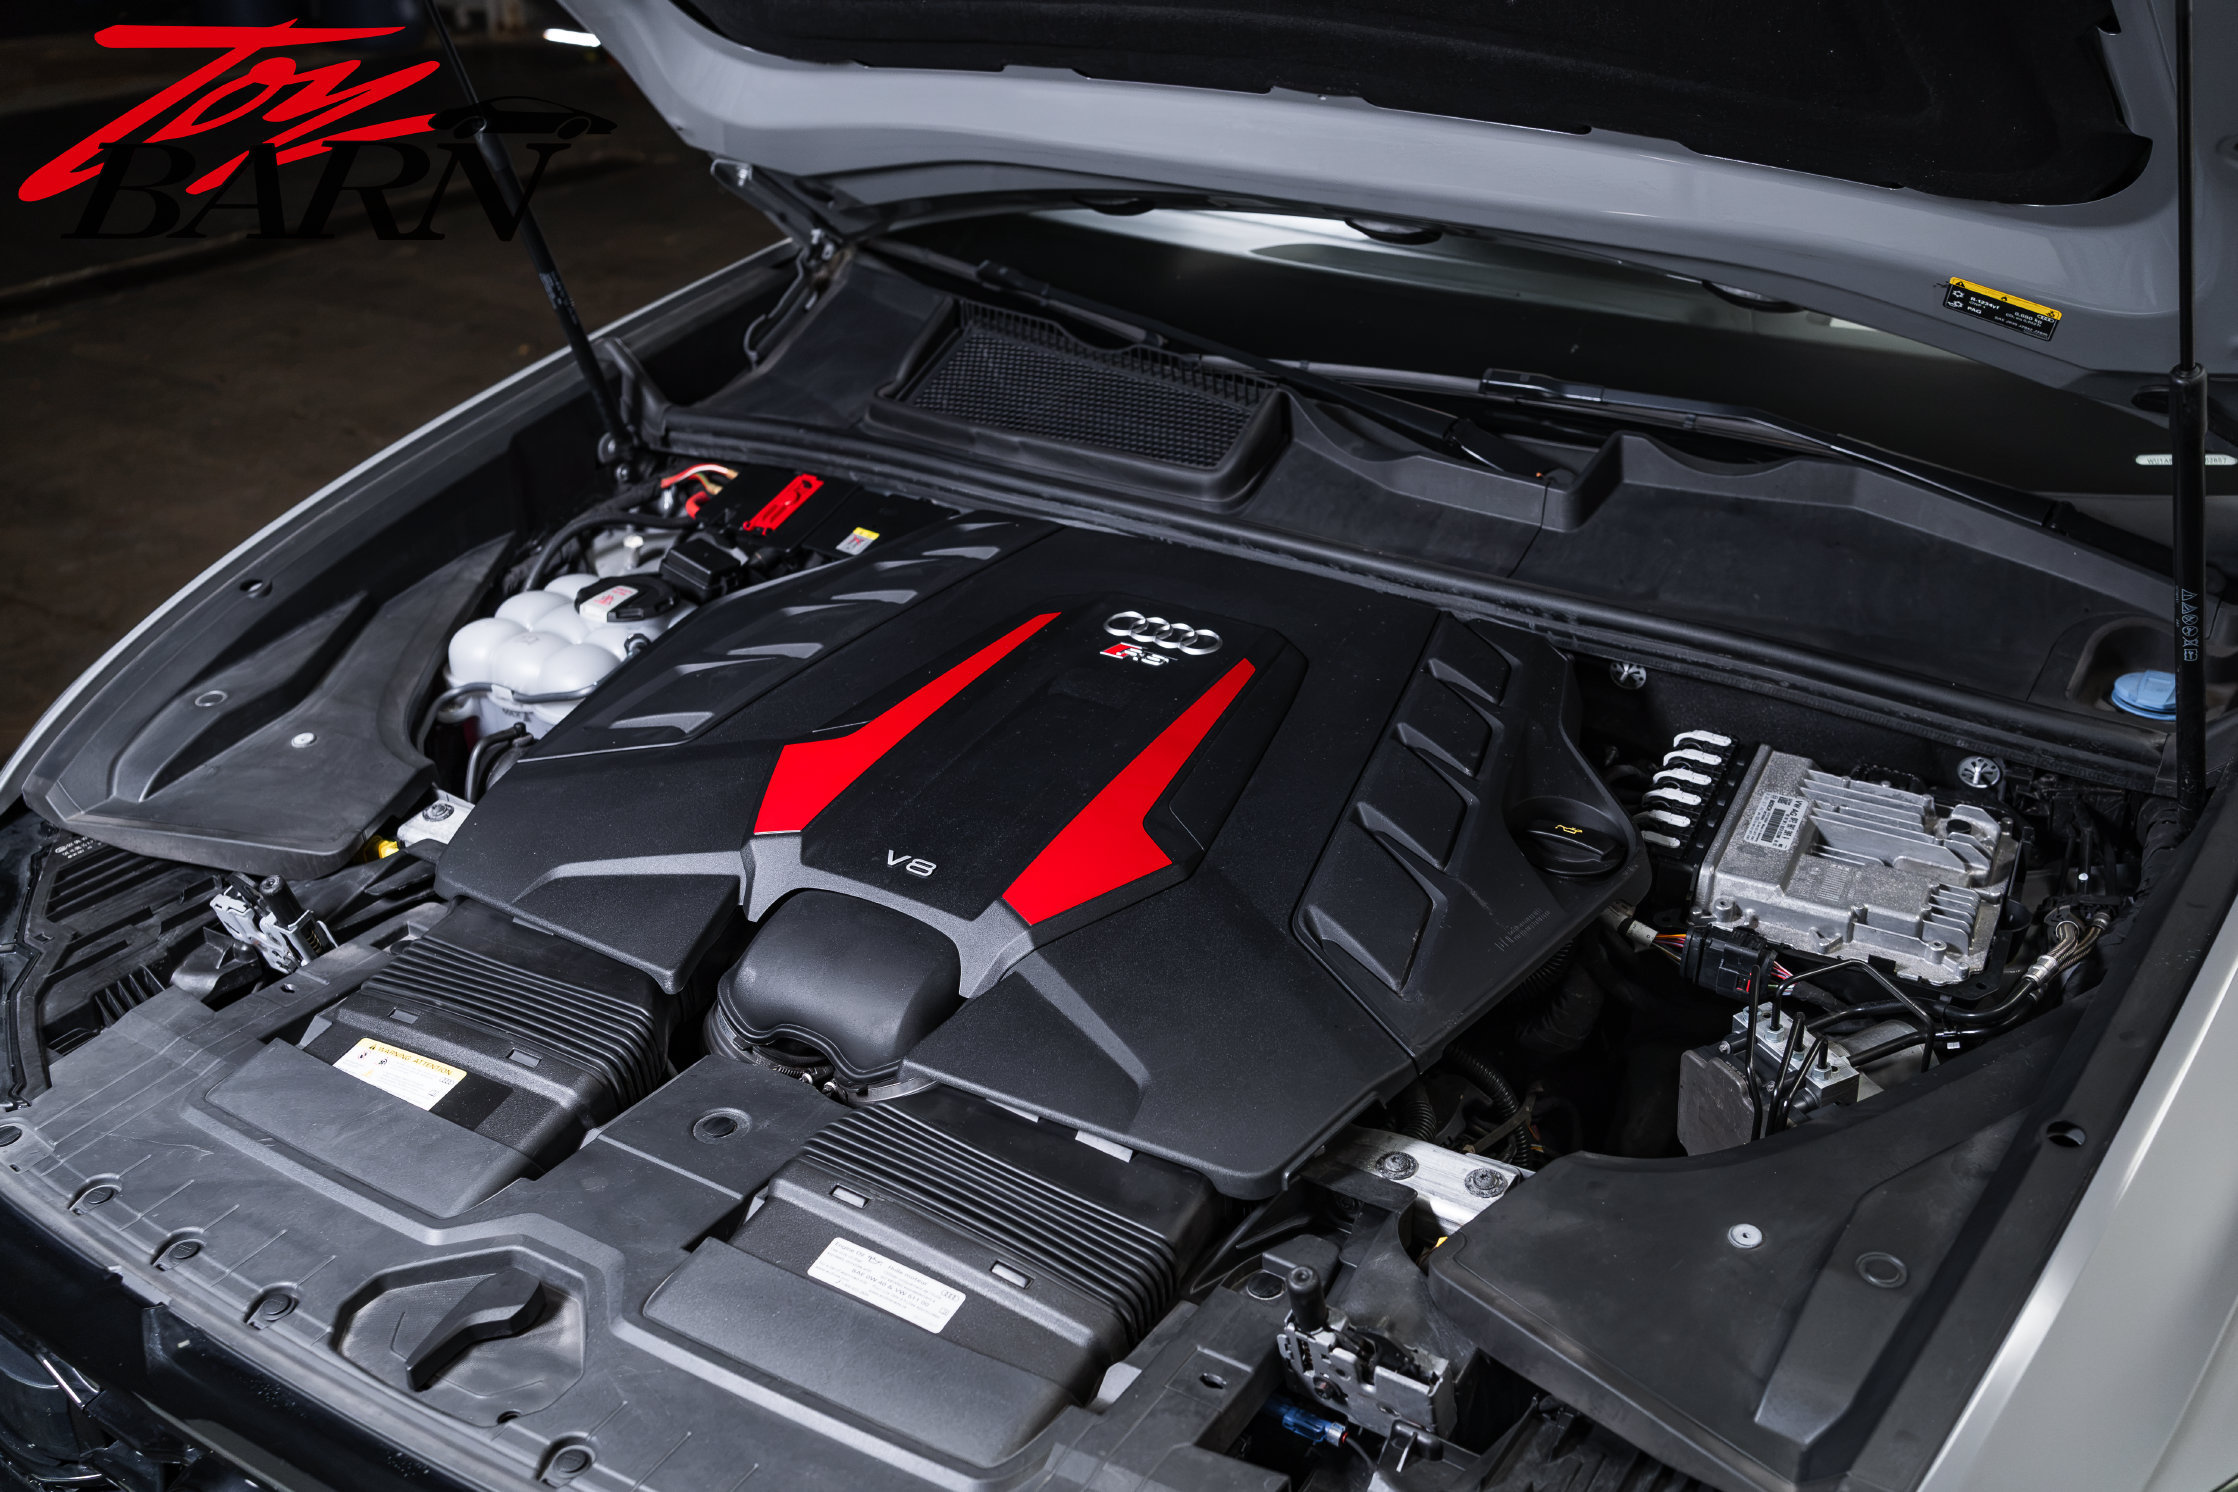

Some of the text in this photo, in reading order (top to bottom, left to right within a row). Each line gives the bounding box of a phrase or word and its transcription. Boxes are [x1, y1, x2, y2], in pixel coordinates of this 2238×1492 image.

[887, 849, 937, 877] V8
[378, 1046, 453, 1076] WARNING ATTENTION
